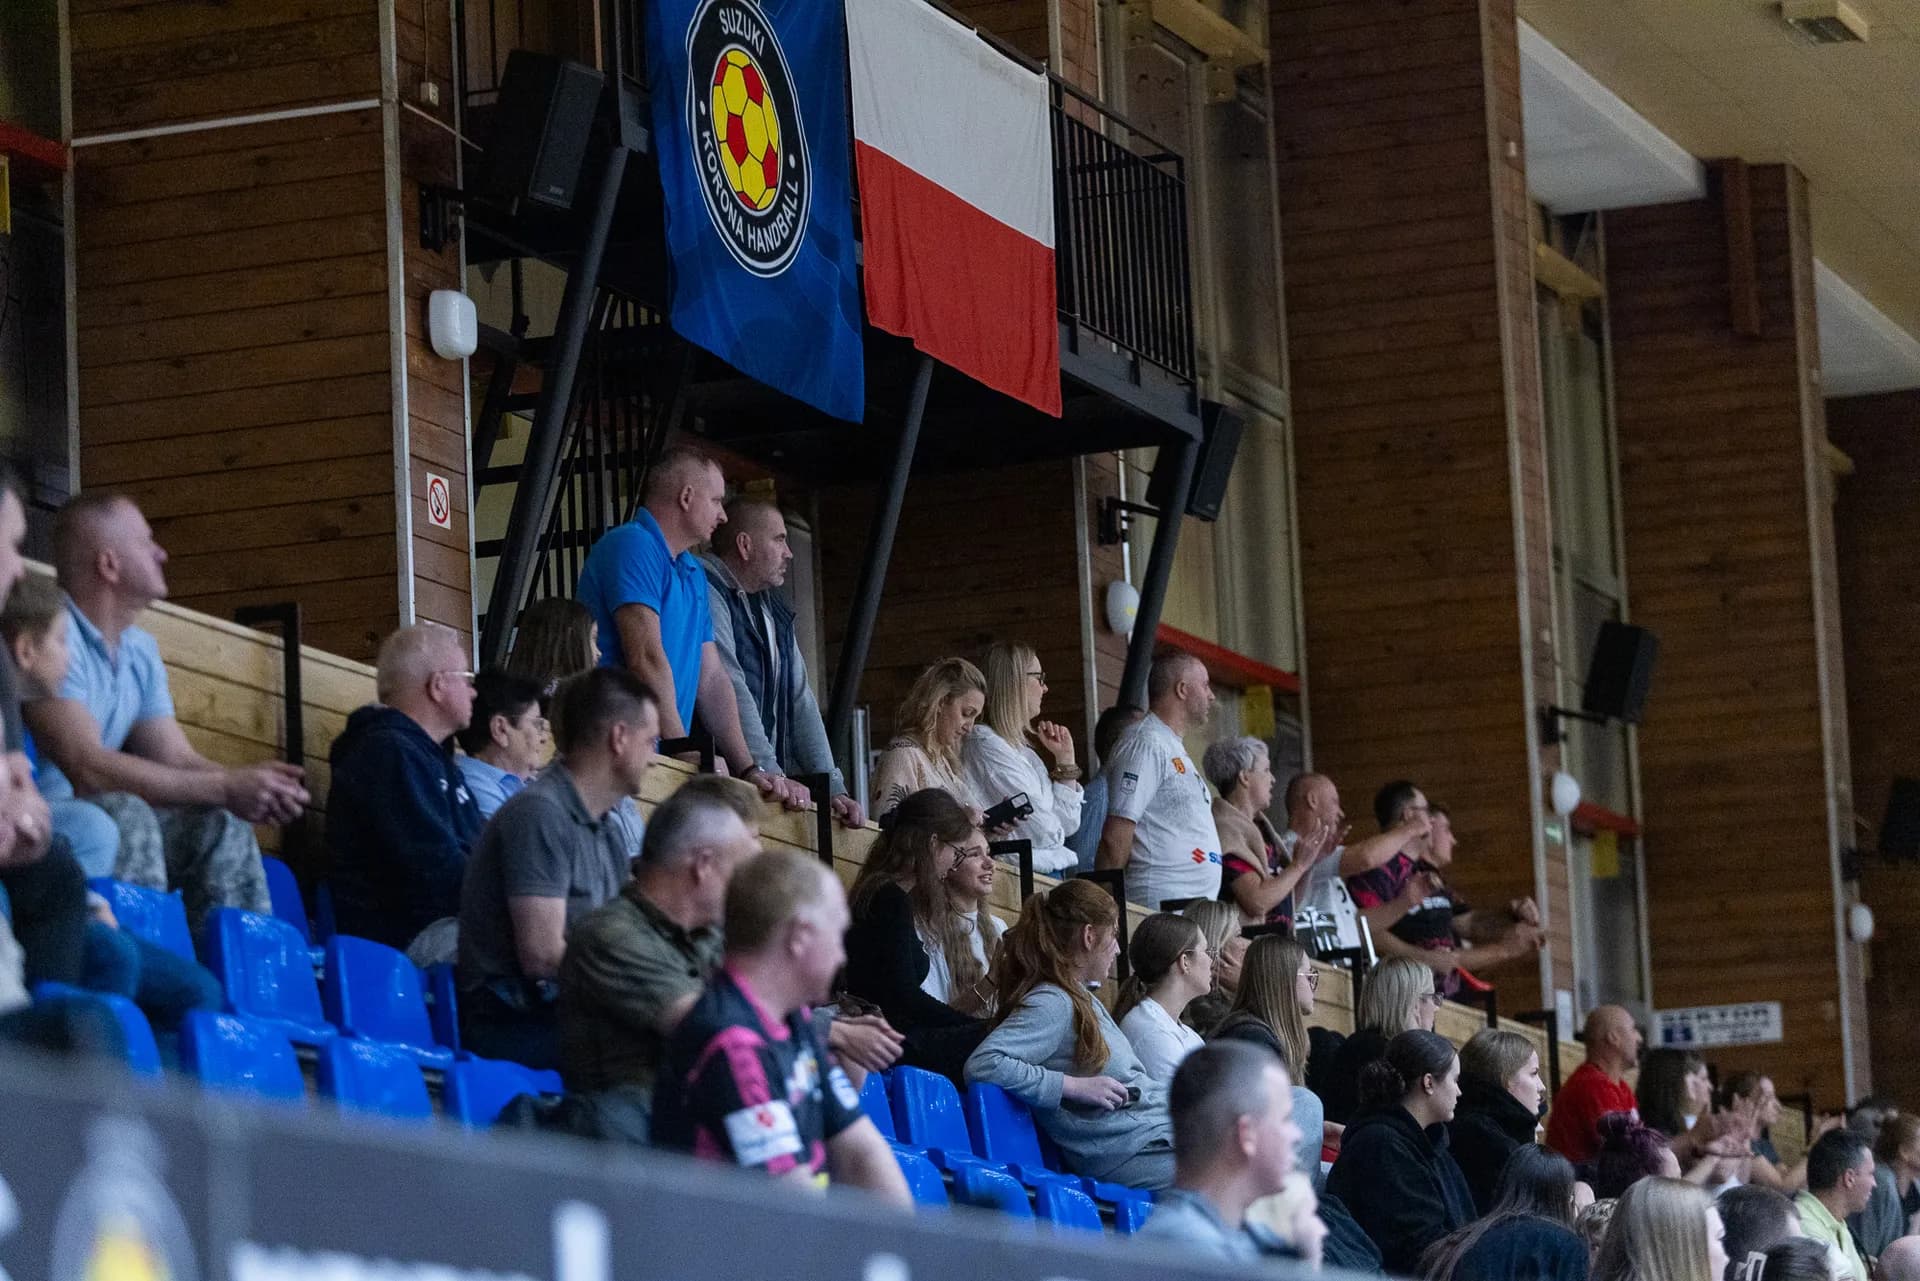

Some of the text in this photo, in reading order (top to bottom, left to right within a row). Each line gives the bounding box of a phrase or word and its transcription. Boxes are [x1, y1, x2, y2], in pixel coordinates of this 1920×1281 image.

[719, 8, 765, 57] SUZUKI
[702, 130, 799, 254] KORONA HANDBALL
